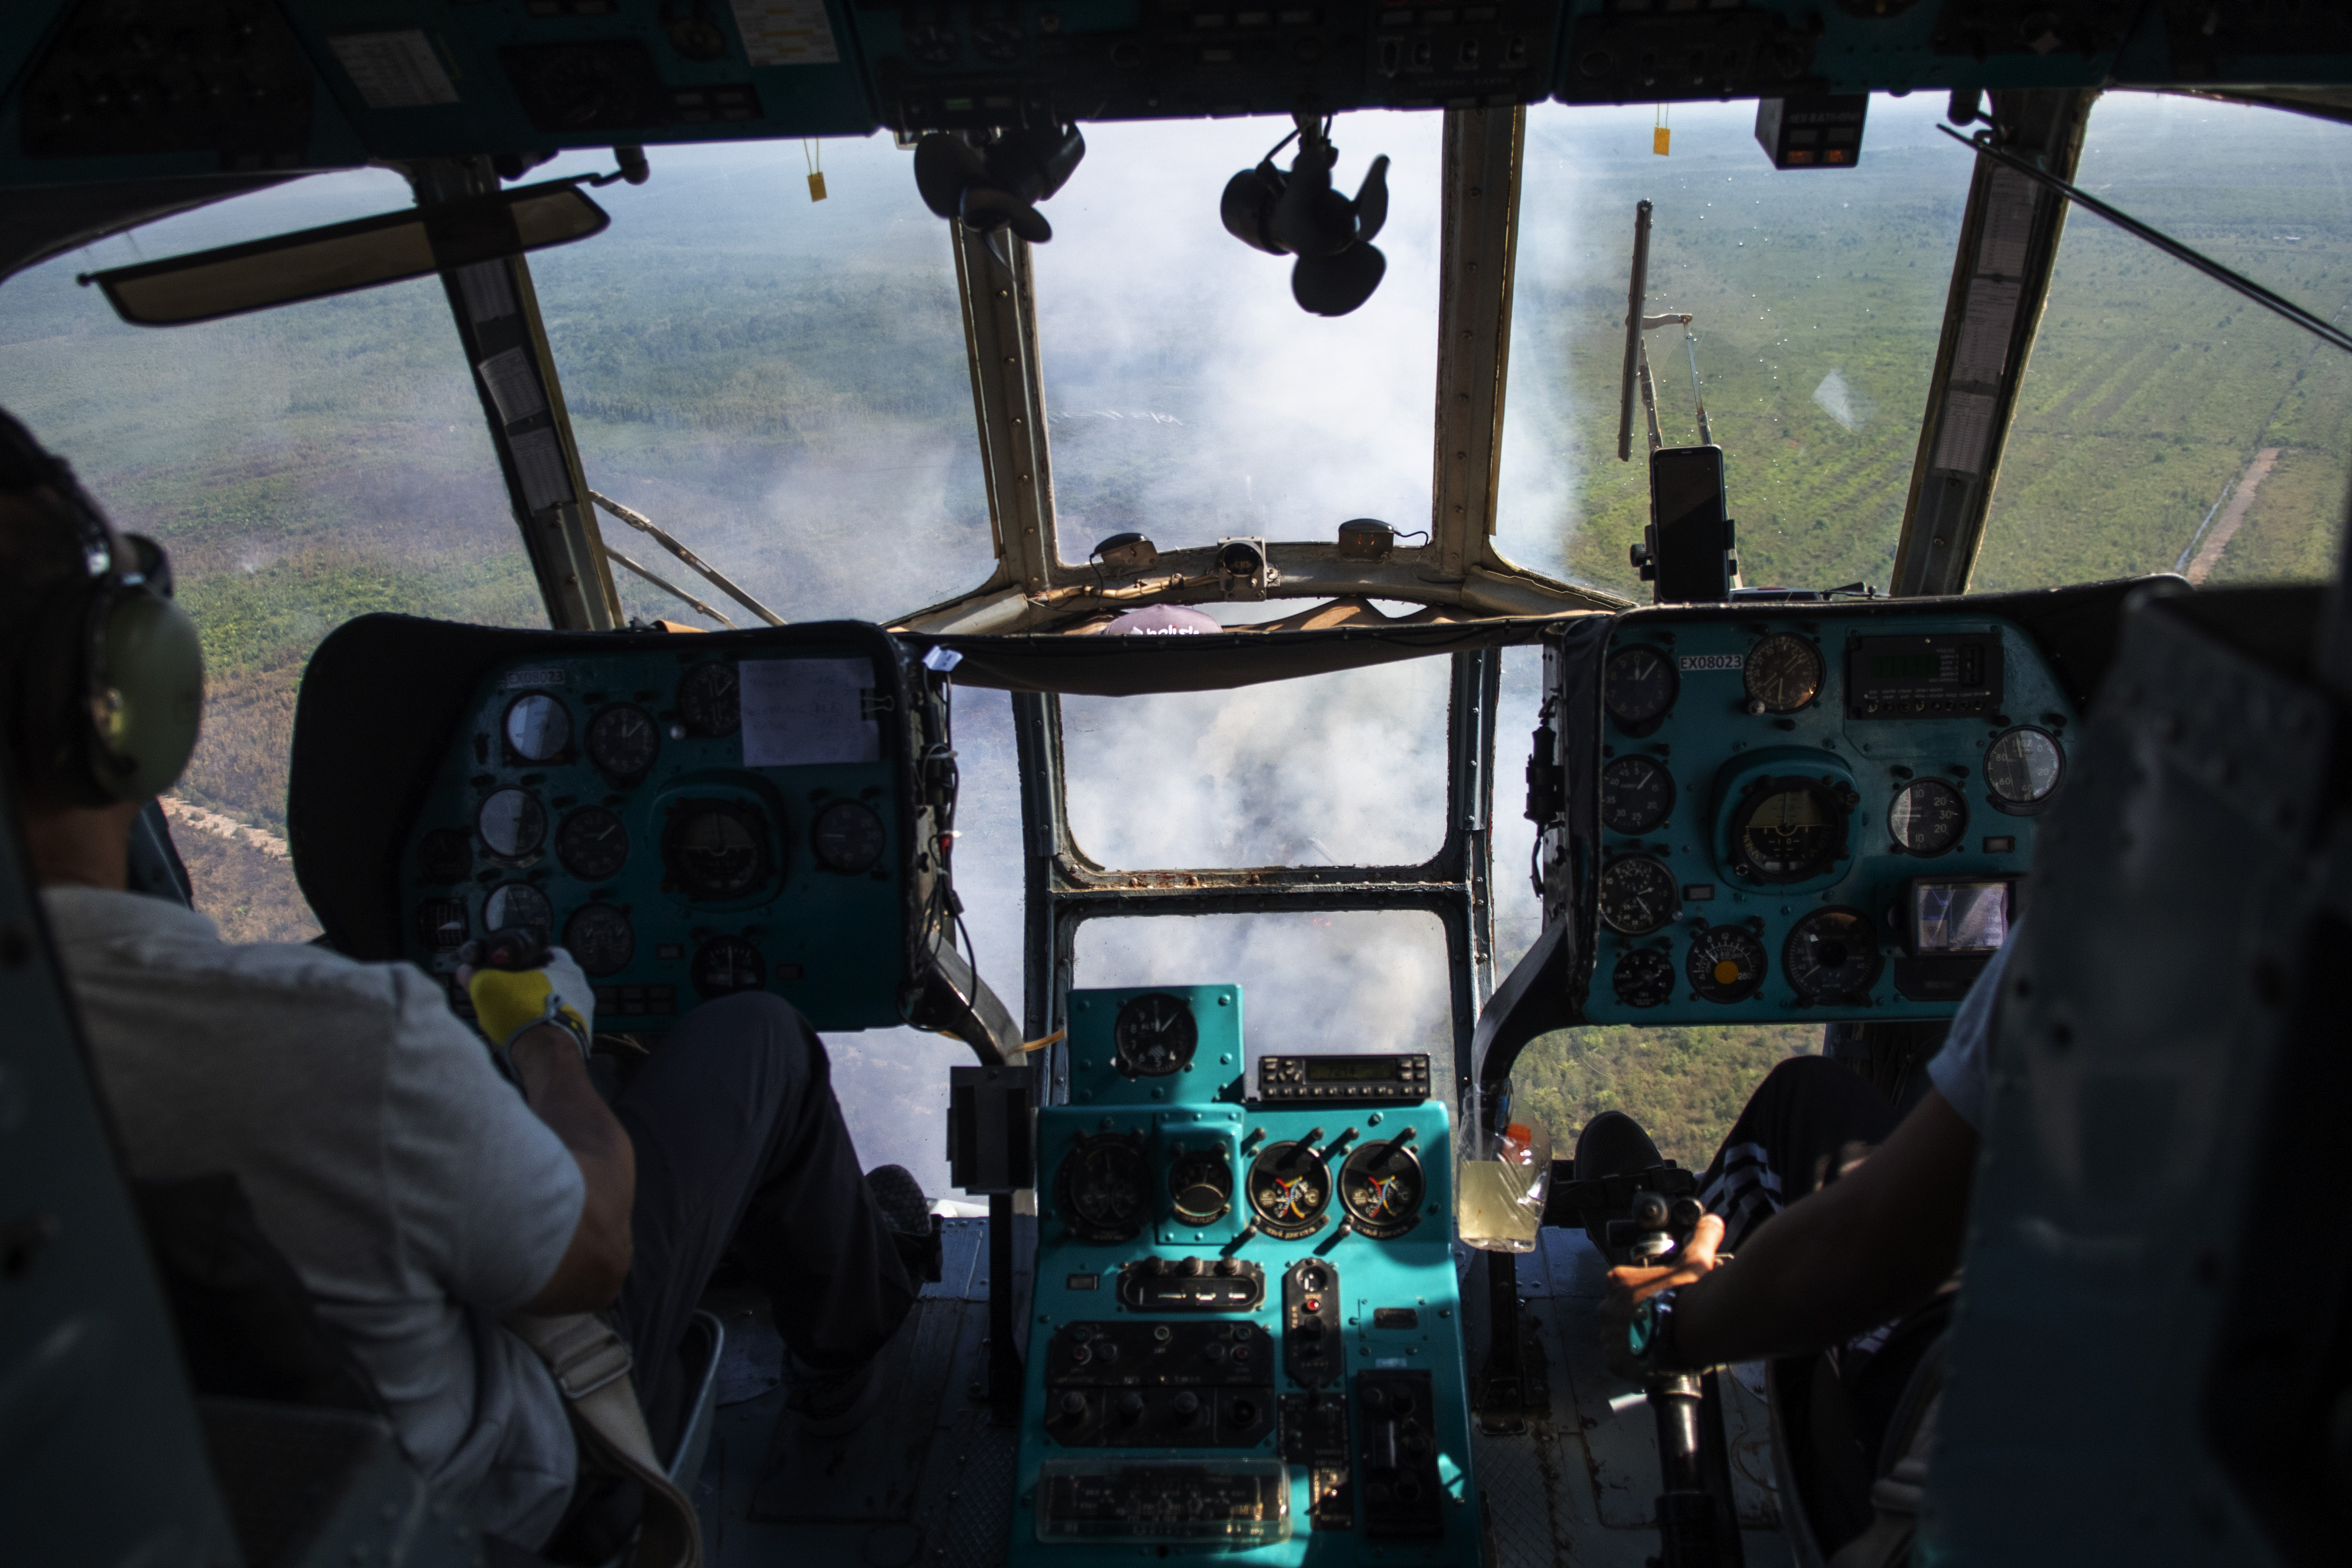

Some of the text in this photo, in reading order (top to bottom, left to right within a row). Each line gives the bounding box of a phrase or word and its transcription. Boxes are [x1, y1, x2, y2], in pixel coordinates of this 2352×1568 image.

[1681, 656, 1742, 669] EX08023
[1915, 789, 1924, 798] 10
[1606, 795, 1616, 804] 35
[1934, 797, 1946, 807] 20
[1646, 801, 1657, 810] 20
[1631, 812, 1642, 820] 25
[1939, 810, 1952, 820] 30
[1934, 824, 1947, 834] 20
[1915, 833, 1924, 842] 10
[1169, 1050, 1177, 1061] 4
[1285, 1226, 1316, 1239] ДВИГАТЕЛЬ
[1357, 1225, 1378, 1236] ПАВЫЙ
